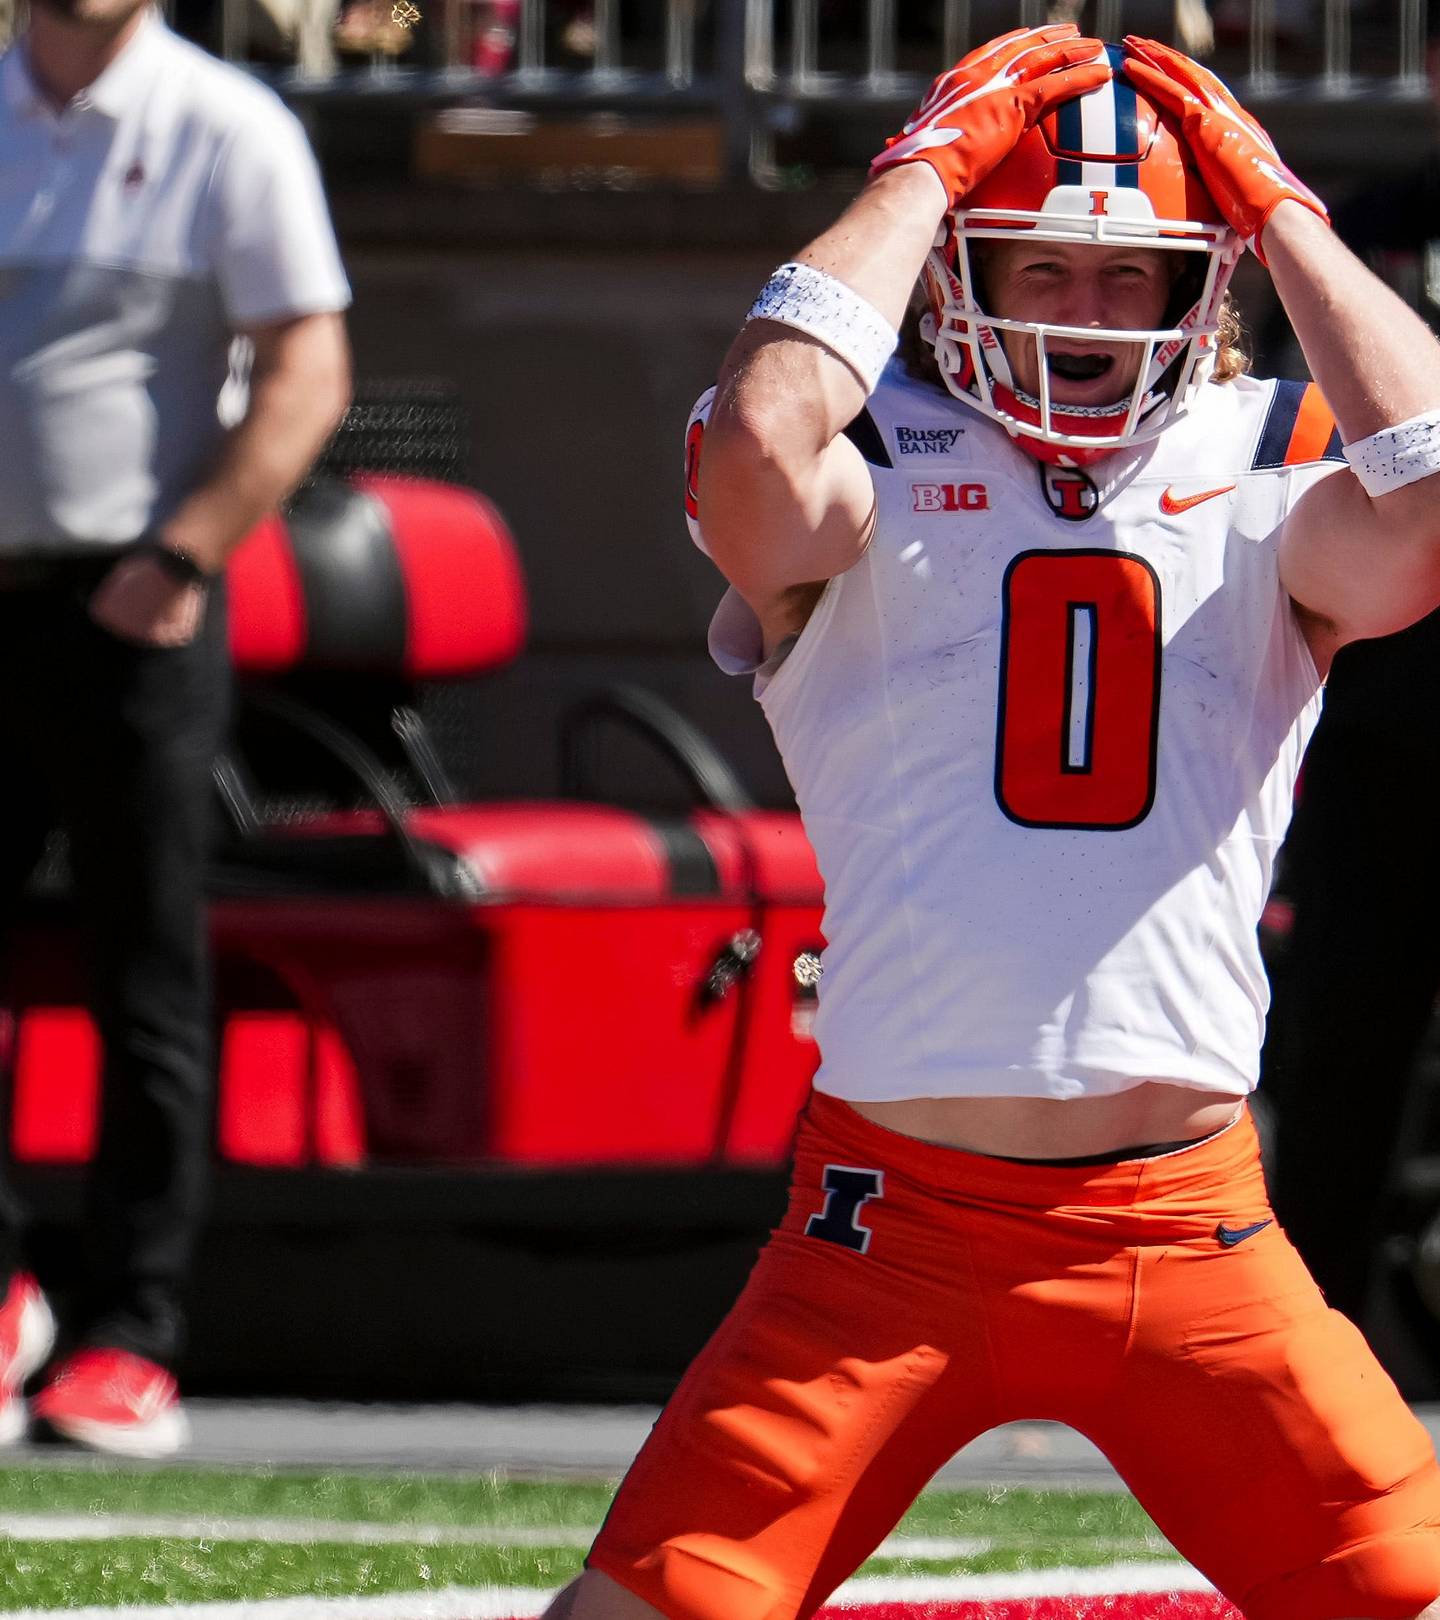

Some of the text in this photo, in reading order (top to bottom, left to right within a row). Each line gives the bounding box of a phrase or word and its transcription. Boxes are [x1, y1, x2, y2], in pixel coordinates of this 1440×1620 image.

[1089, 191, 1108, 216] I
[895, 427, 965, 446] Busey
[899, 442, 950, 454] BANK
[994, 548, 1163, 831] 0
[804, 1164, 885, 1255] I
